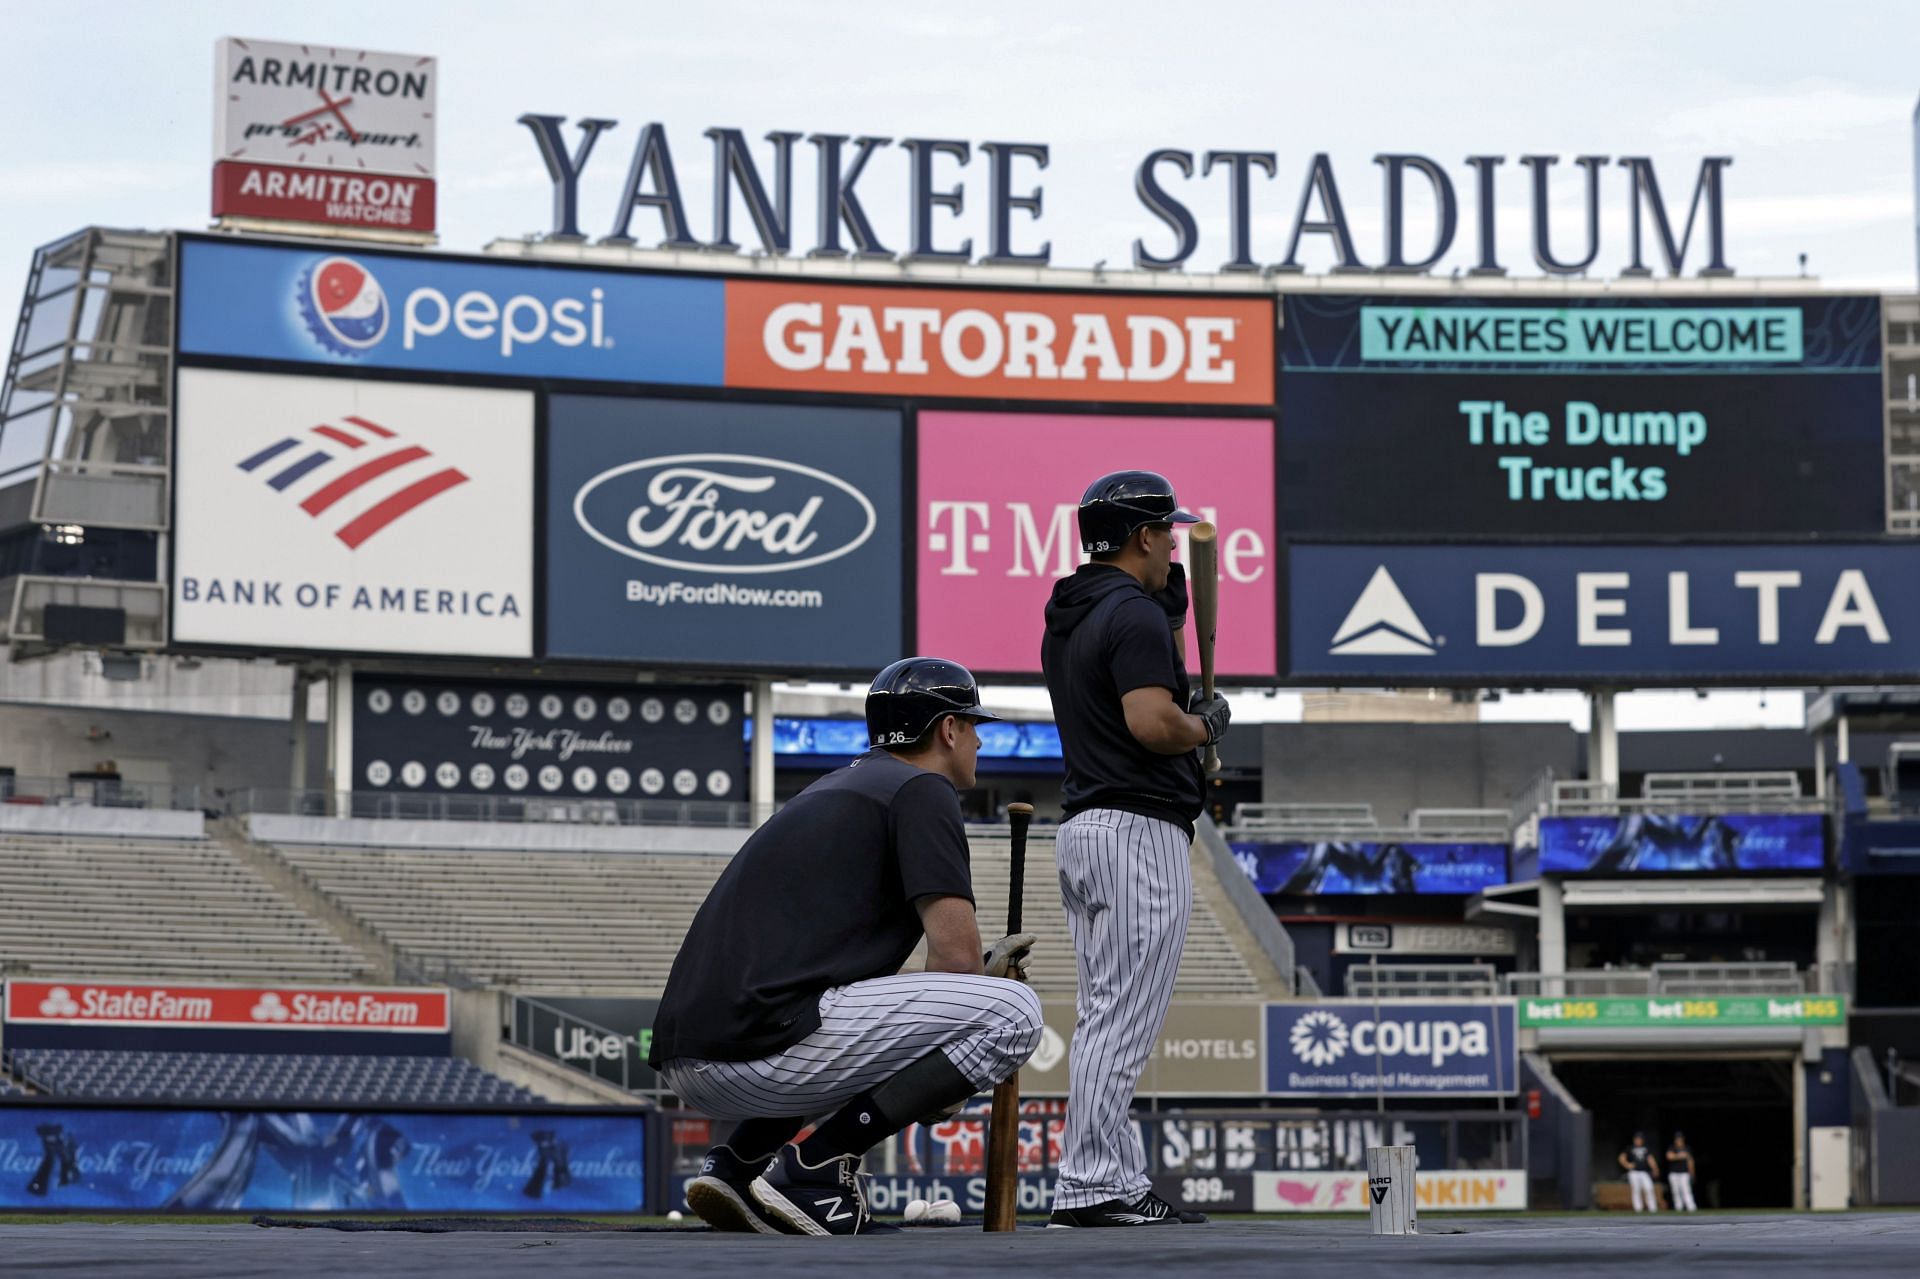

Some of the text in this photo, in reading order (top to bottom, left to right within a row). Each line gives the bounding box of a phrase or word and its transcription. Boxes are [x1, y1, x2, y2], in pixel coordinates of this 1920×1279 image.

[233, 56, 428, 99] ARMITRON
[240, 170, 416, 208] ARMITRON
[517, 113, 1735, 278] YANKEE STADIUM
[326, 202, 412, 225] WATCHES
[404, 288, 605, 356] pepsi
[1378, 317, 1786, 353] YANKEES WELCOME
[763, 302, 1235, 383] GATORADE
[1459, 401, 1707, 456] The Dump
[1499, 456, 1667, 500] Trucks
[627, 467, 823, 554] Ford
[1096, 541, 1109, 551] 39
[182, 576, 520, 619] BANK OF AMERICA
[626, 580, 822, 607] BuyFordNow.com
[1476, 569, 1891, 646] DELTA
[469, 725, 633, 762] New York Yankees
[889, 731, 905, 743] 26
[1357, 927, 1505, 947] YES TERRACE
[1527, 1000, 1598, 1018] bet365
[1648, 1000, 1719, 1018] bet365
[1768, 1000, 1838, 1018] bet365
[1165, 1039, 1256, 1060] HOTELS
[1351, 1019, 1489, 1067] coupa
[1288, 1072, 1347, 1088] Business
[1398, 1073, 1489, 1092] Management
[411, 1142, 472, 1177] New
[1181, 1177, 1223, 1202] 399
